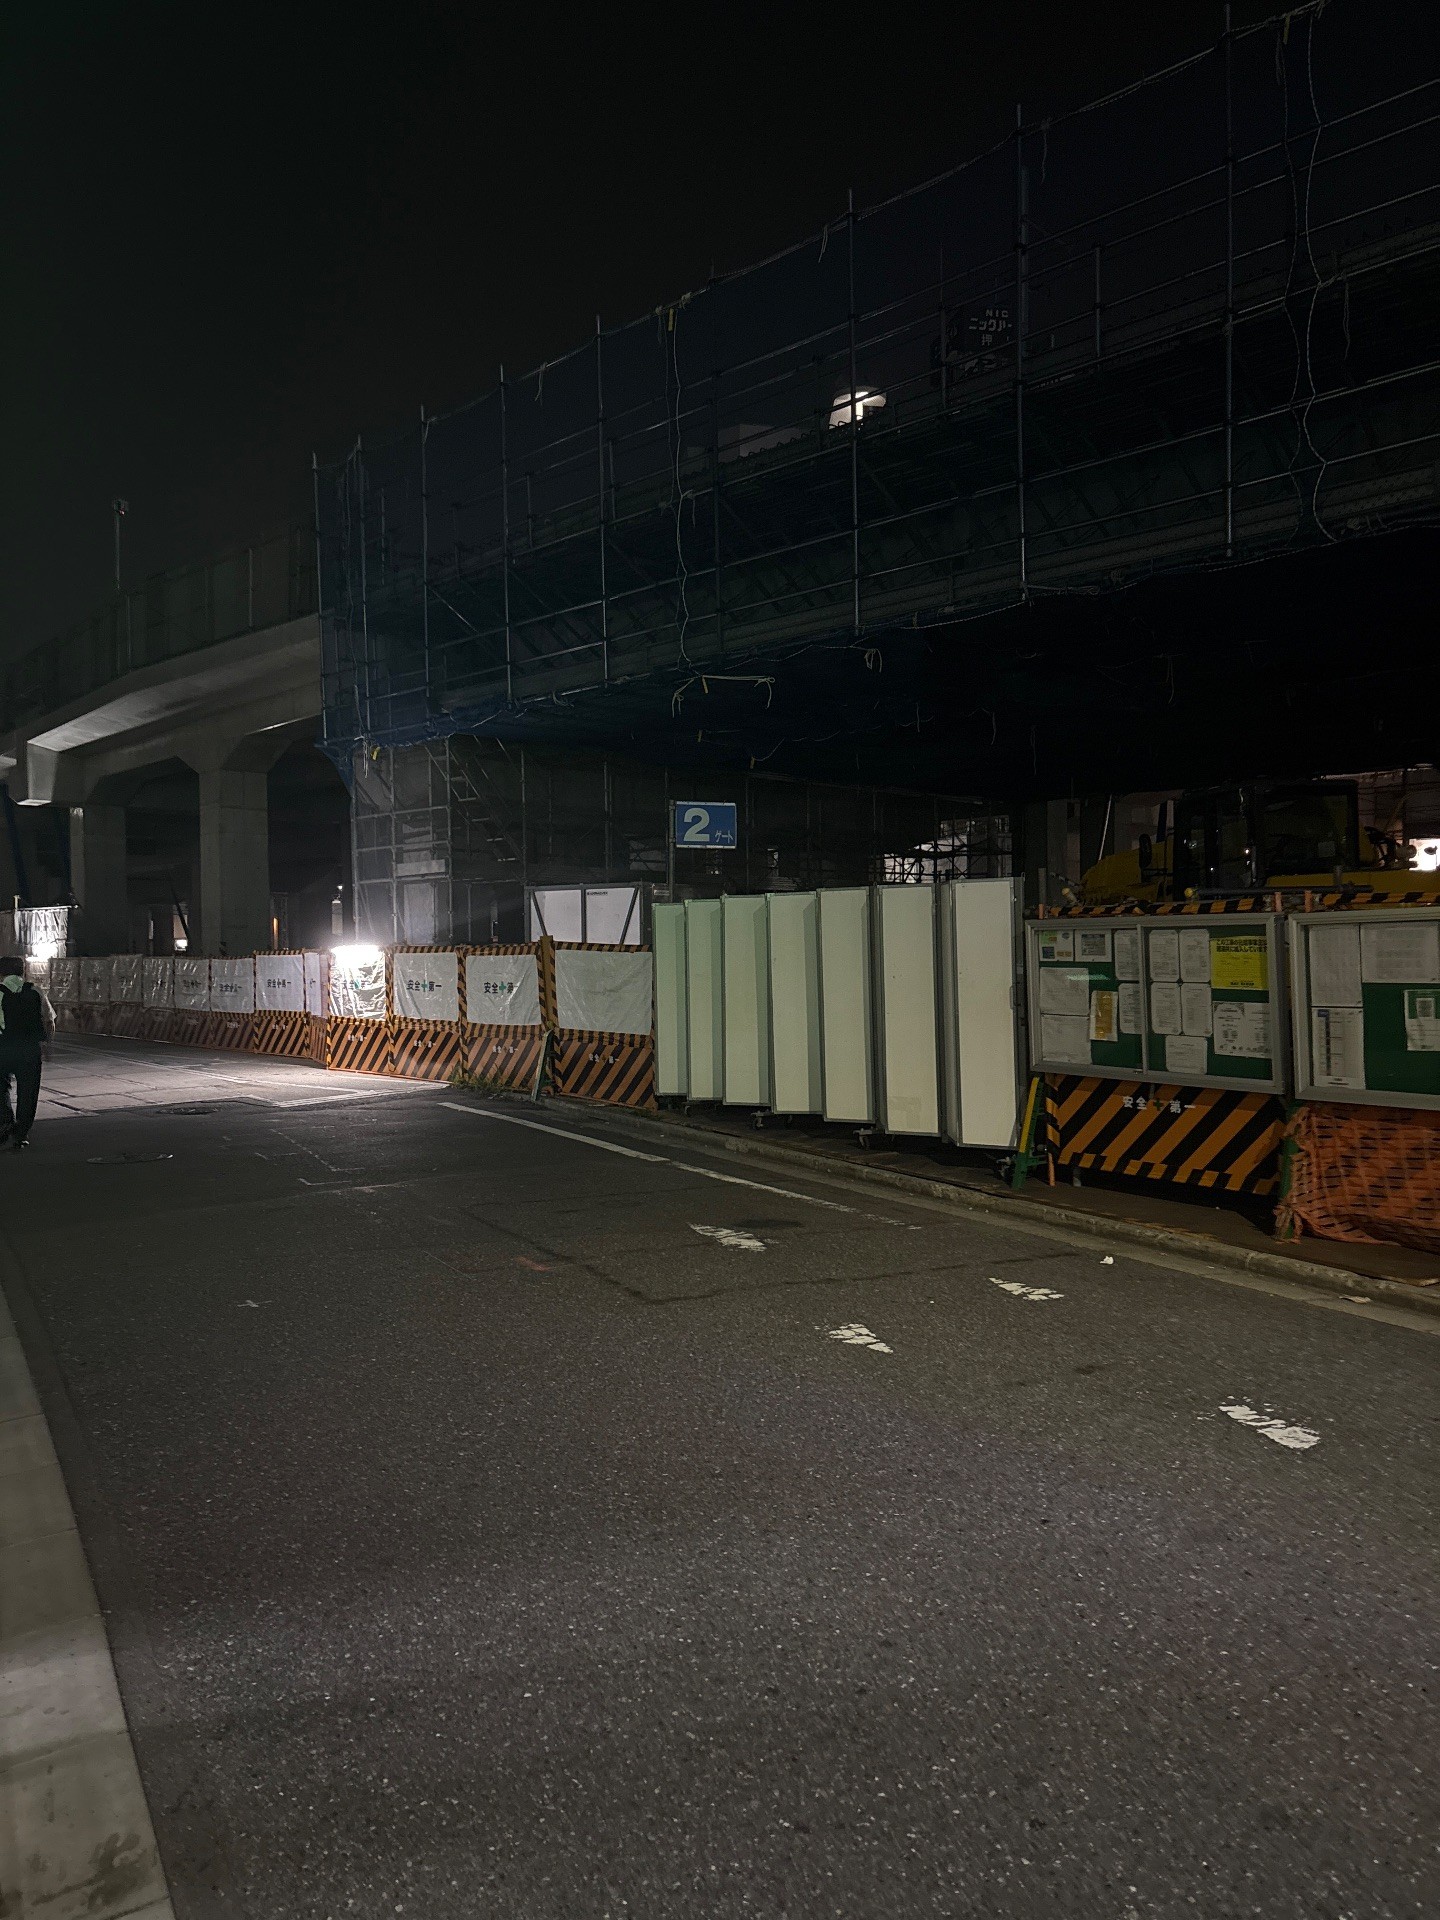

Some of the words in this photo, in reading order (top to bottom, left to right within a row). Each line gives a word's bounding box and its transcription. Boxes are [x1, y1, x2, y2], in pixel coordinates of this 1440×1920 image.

[684, 808, 710, 841] 2
[715, 830, 734, 843] ゲート
